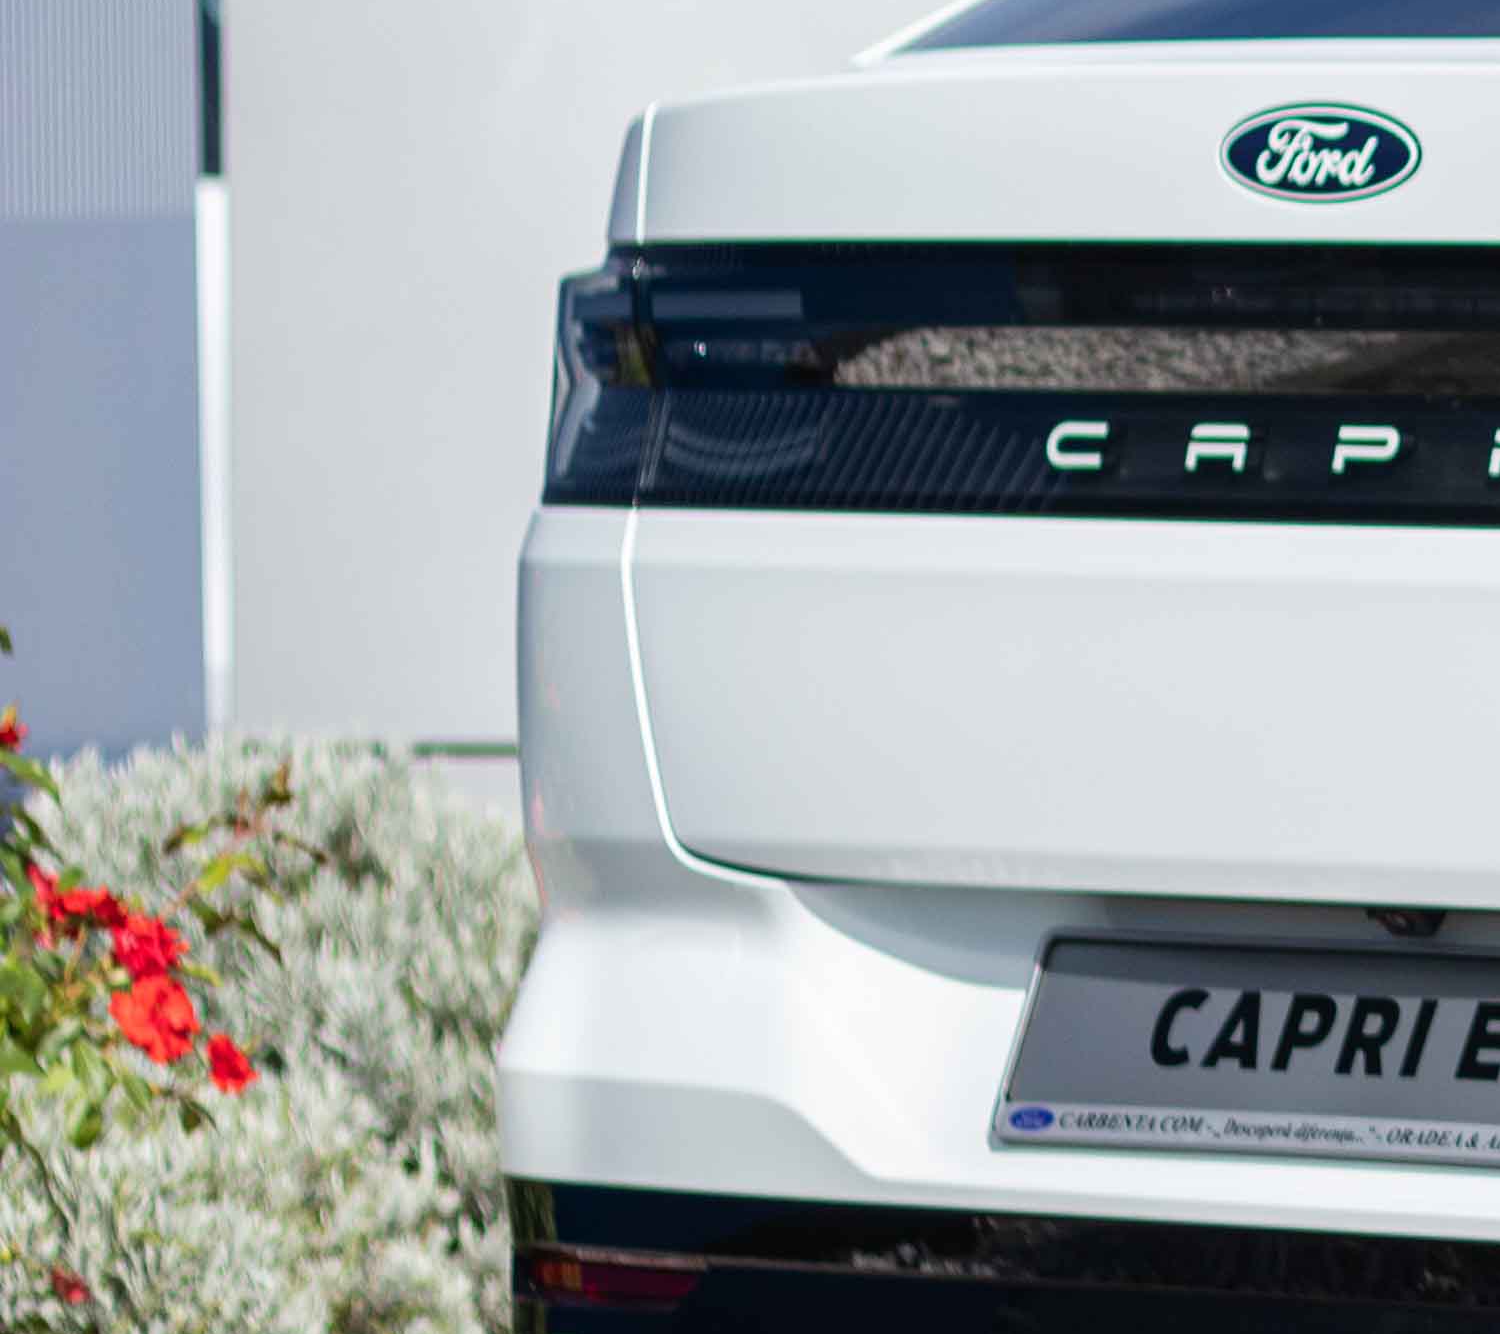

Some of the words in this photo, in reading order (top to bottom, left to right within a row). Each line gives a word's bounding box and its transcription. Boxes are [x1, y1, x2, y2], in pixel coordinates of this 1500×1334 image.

[1255, 118, 1380, 187] Ford
[1149, 987, 1440, 1078] CAPRI
[1058, 1112, 1156, 1133] CARBENTA
[1159, 1115, 1204, 1135] COM
[1385, 1126, 1461, 1149] ORADEA
[1464, 1130, 1478, 1149] &
